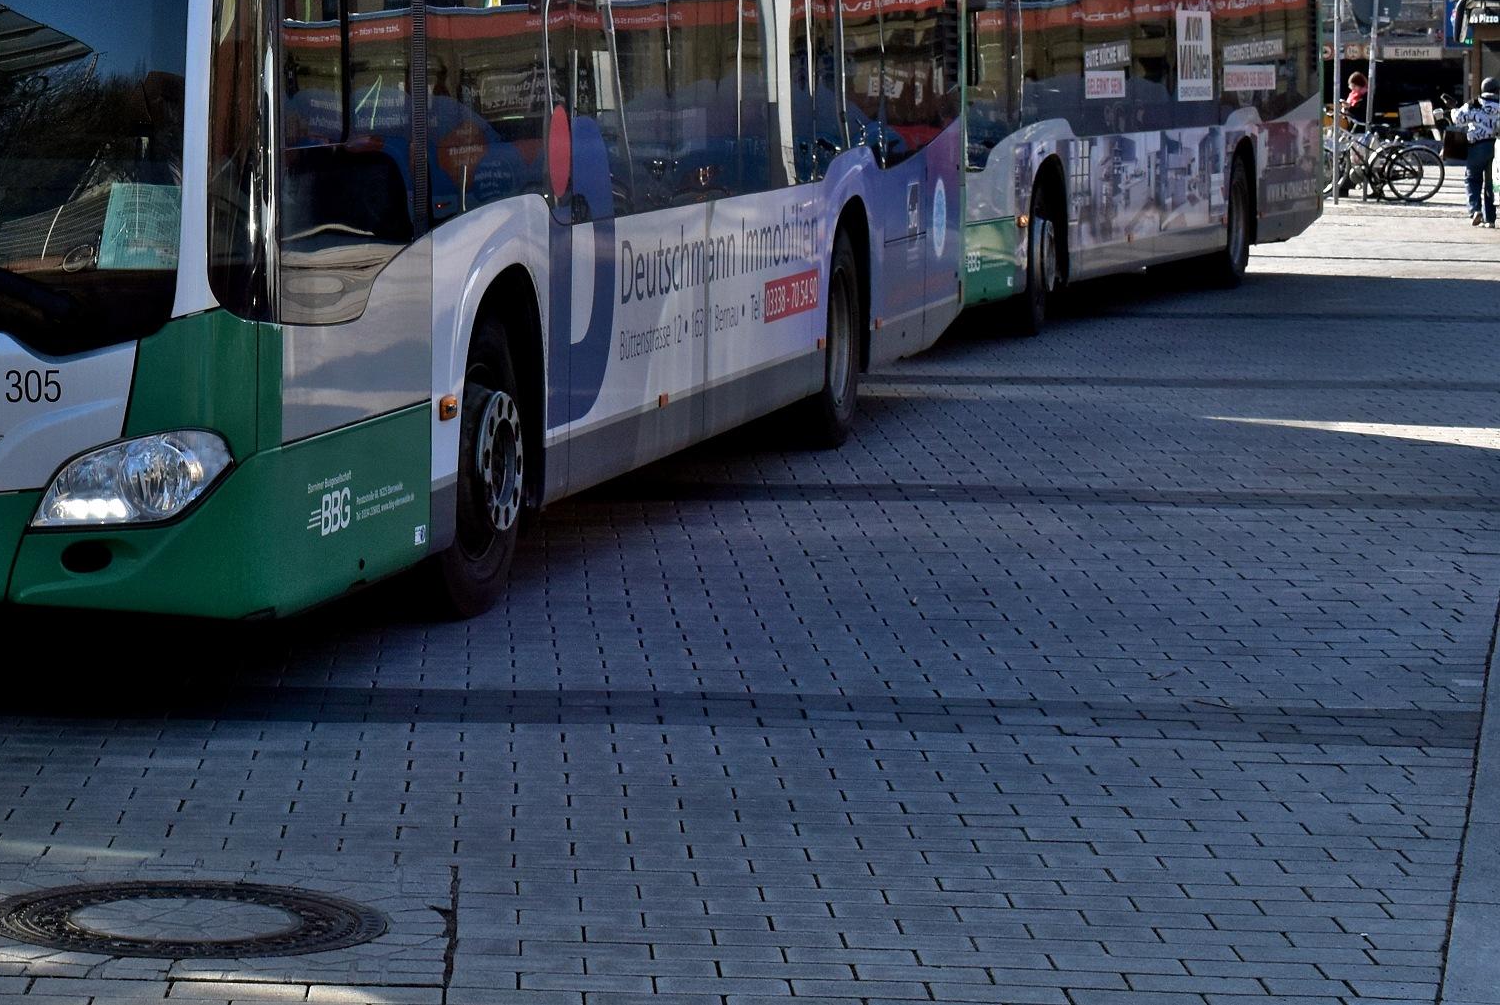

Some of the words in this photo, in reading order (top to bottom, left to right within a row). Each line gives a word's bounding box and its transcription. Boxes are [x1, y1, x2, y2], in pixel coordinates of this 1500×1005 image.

[1479, 13, 1499, 23] Pizza
[1394, 49, 1430, 57] Einfahrt
[620, 224, 736, 305] Deutschmann
[741, 203, 819, 274] Immobilien
[673, 315, 682, 344] 12
[714, 304, 739, 332] Bernau
[765, 284, 786, 317] 03338
[5, 369, 62, 403] 305
[320, 486, 351, 537] BBG
